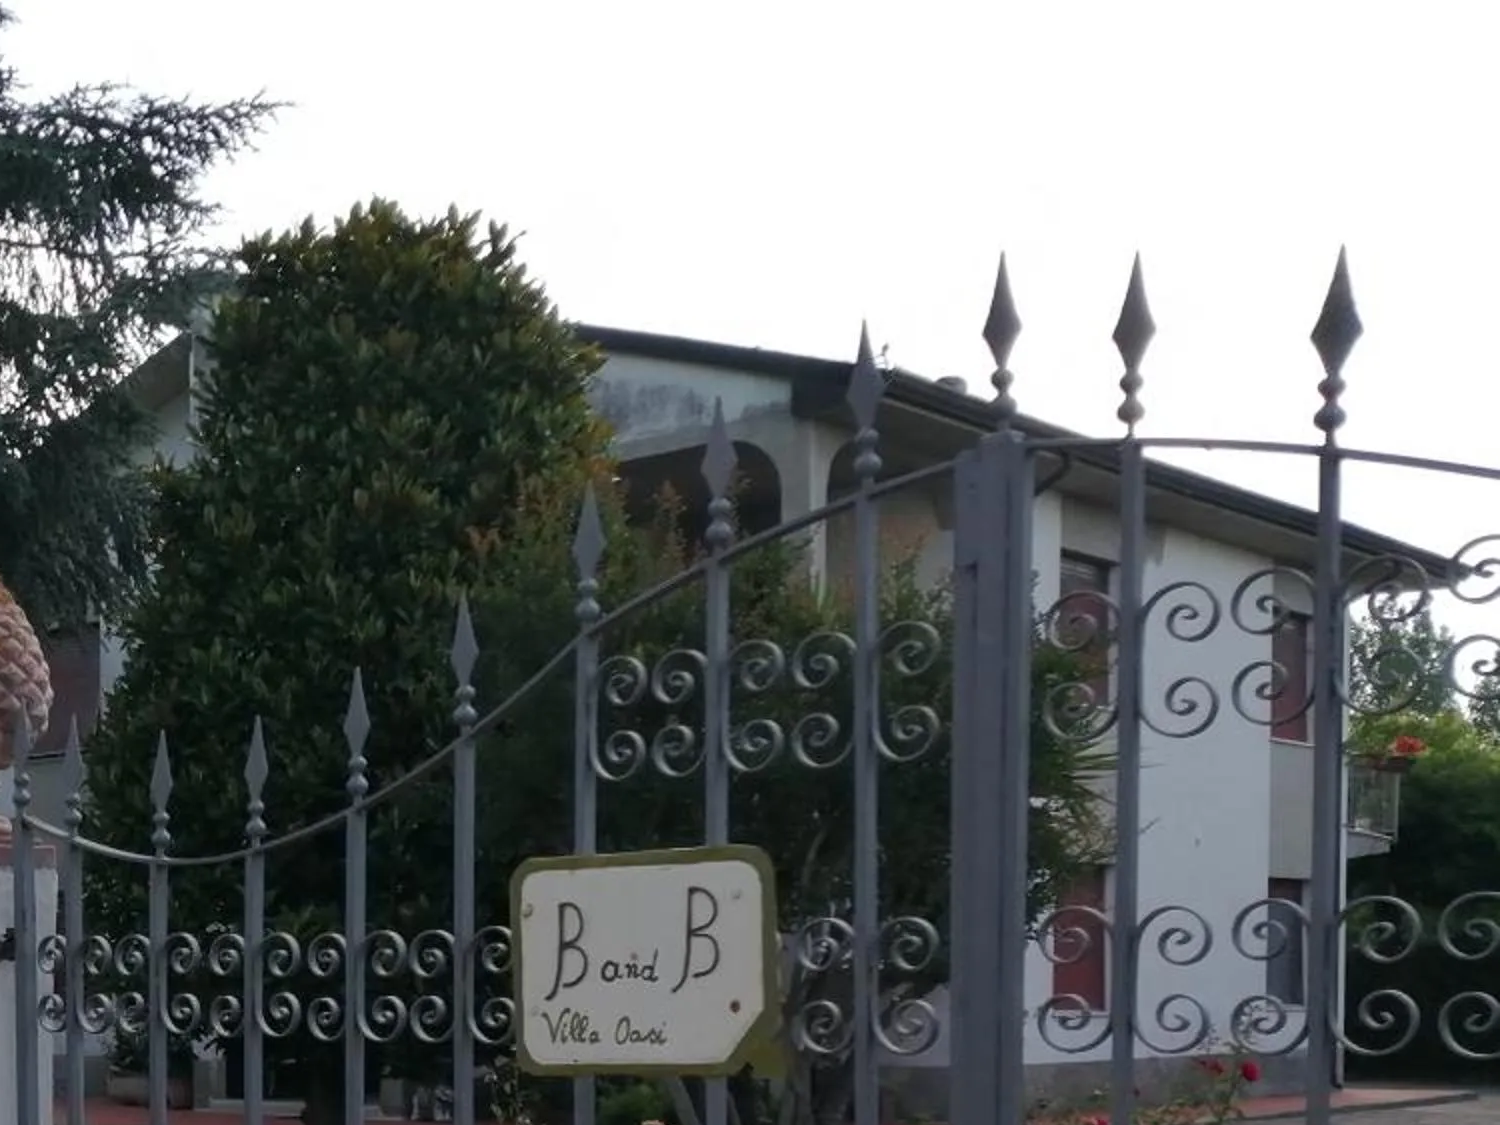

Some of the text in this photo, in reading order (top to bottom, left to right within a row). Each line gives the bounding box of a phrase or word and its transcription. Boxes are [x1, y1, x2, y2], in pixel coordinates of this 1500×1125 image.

[544, 886, 720, 1001] B and B
[541, 1007, 668, 1045] Villa Oasi
